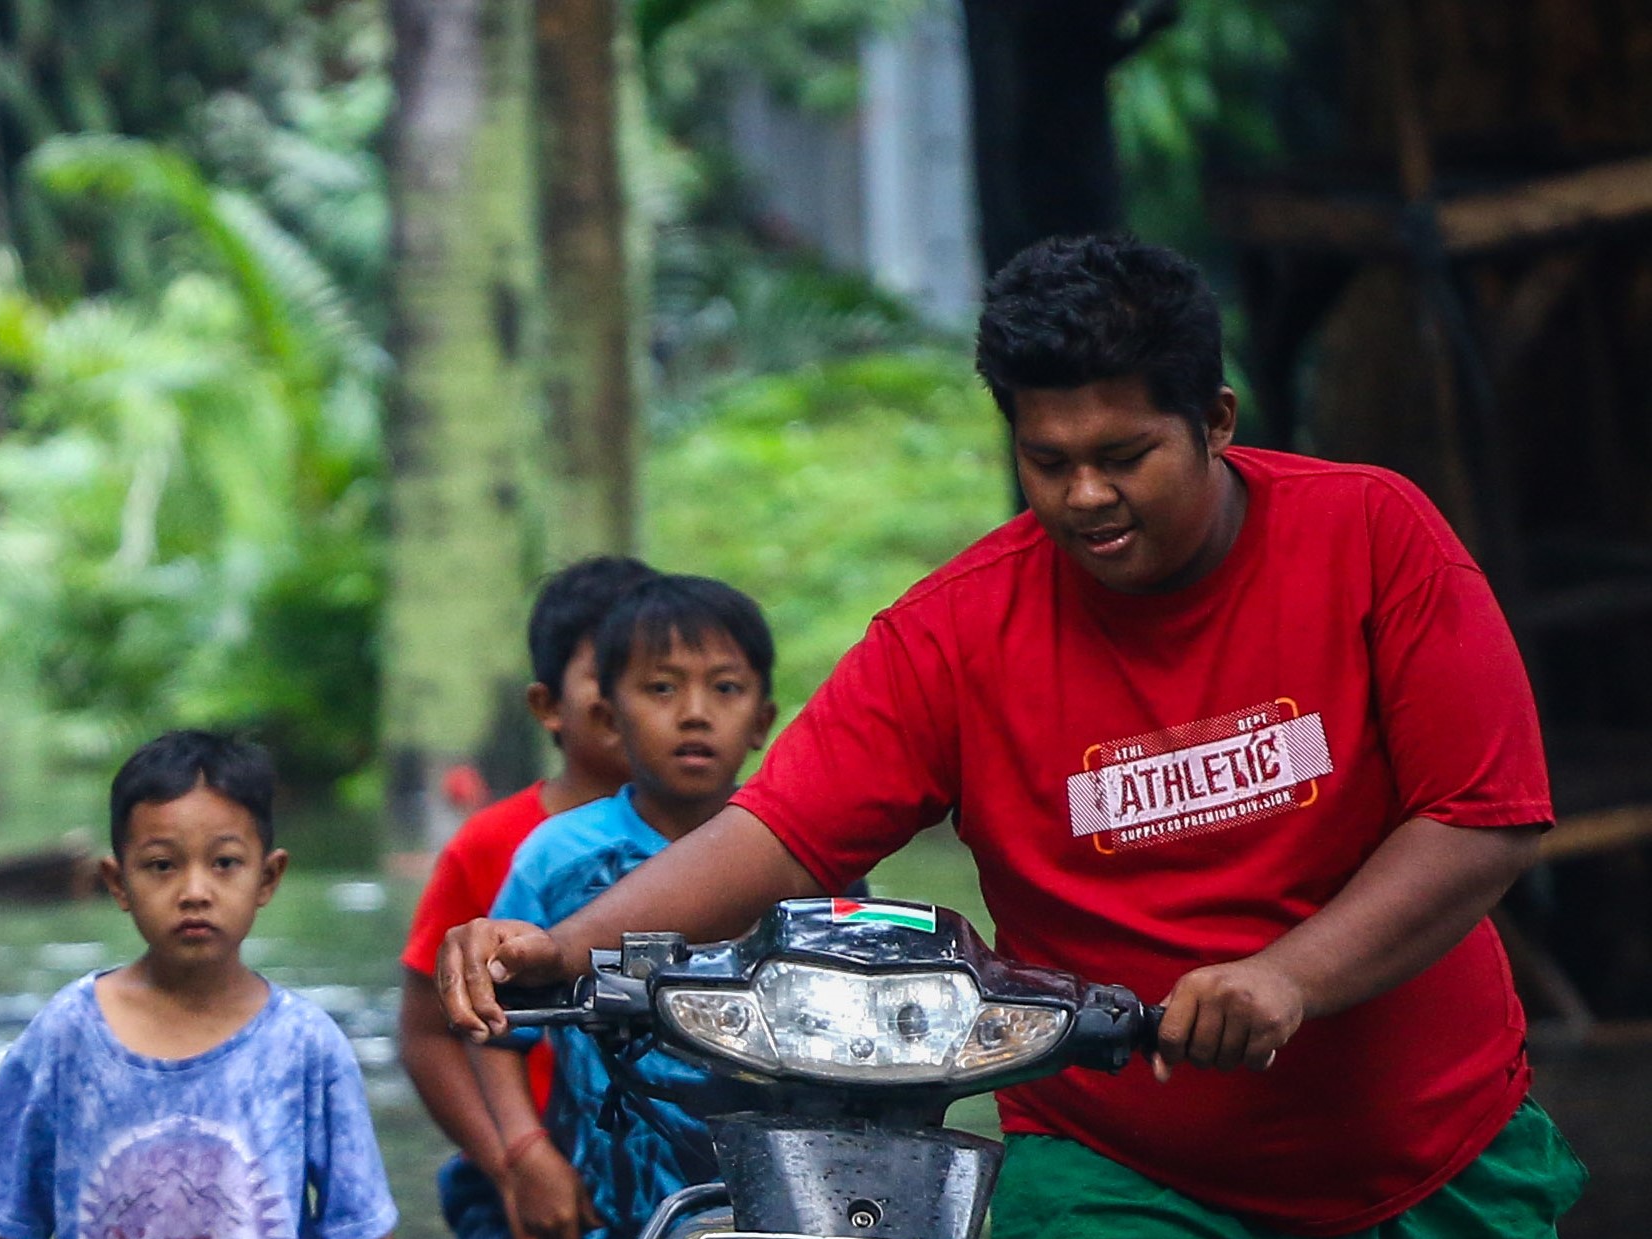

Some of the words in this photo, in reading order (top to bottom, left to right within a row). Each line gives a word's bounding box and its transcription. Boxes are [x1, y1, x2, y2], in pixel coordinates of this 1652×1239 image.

[1237, 712, 1267, 731] DEPT
[1117, 731, 1281, 818] ATHLETIC
[1120, 822, 1166, 842] SUPPLY
[1167, 818, 1182, 832] CO
[1184, 806, 1236, 828] PREMIUM
